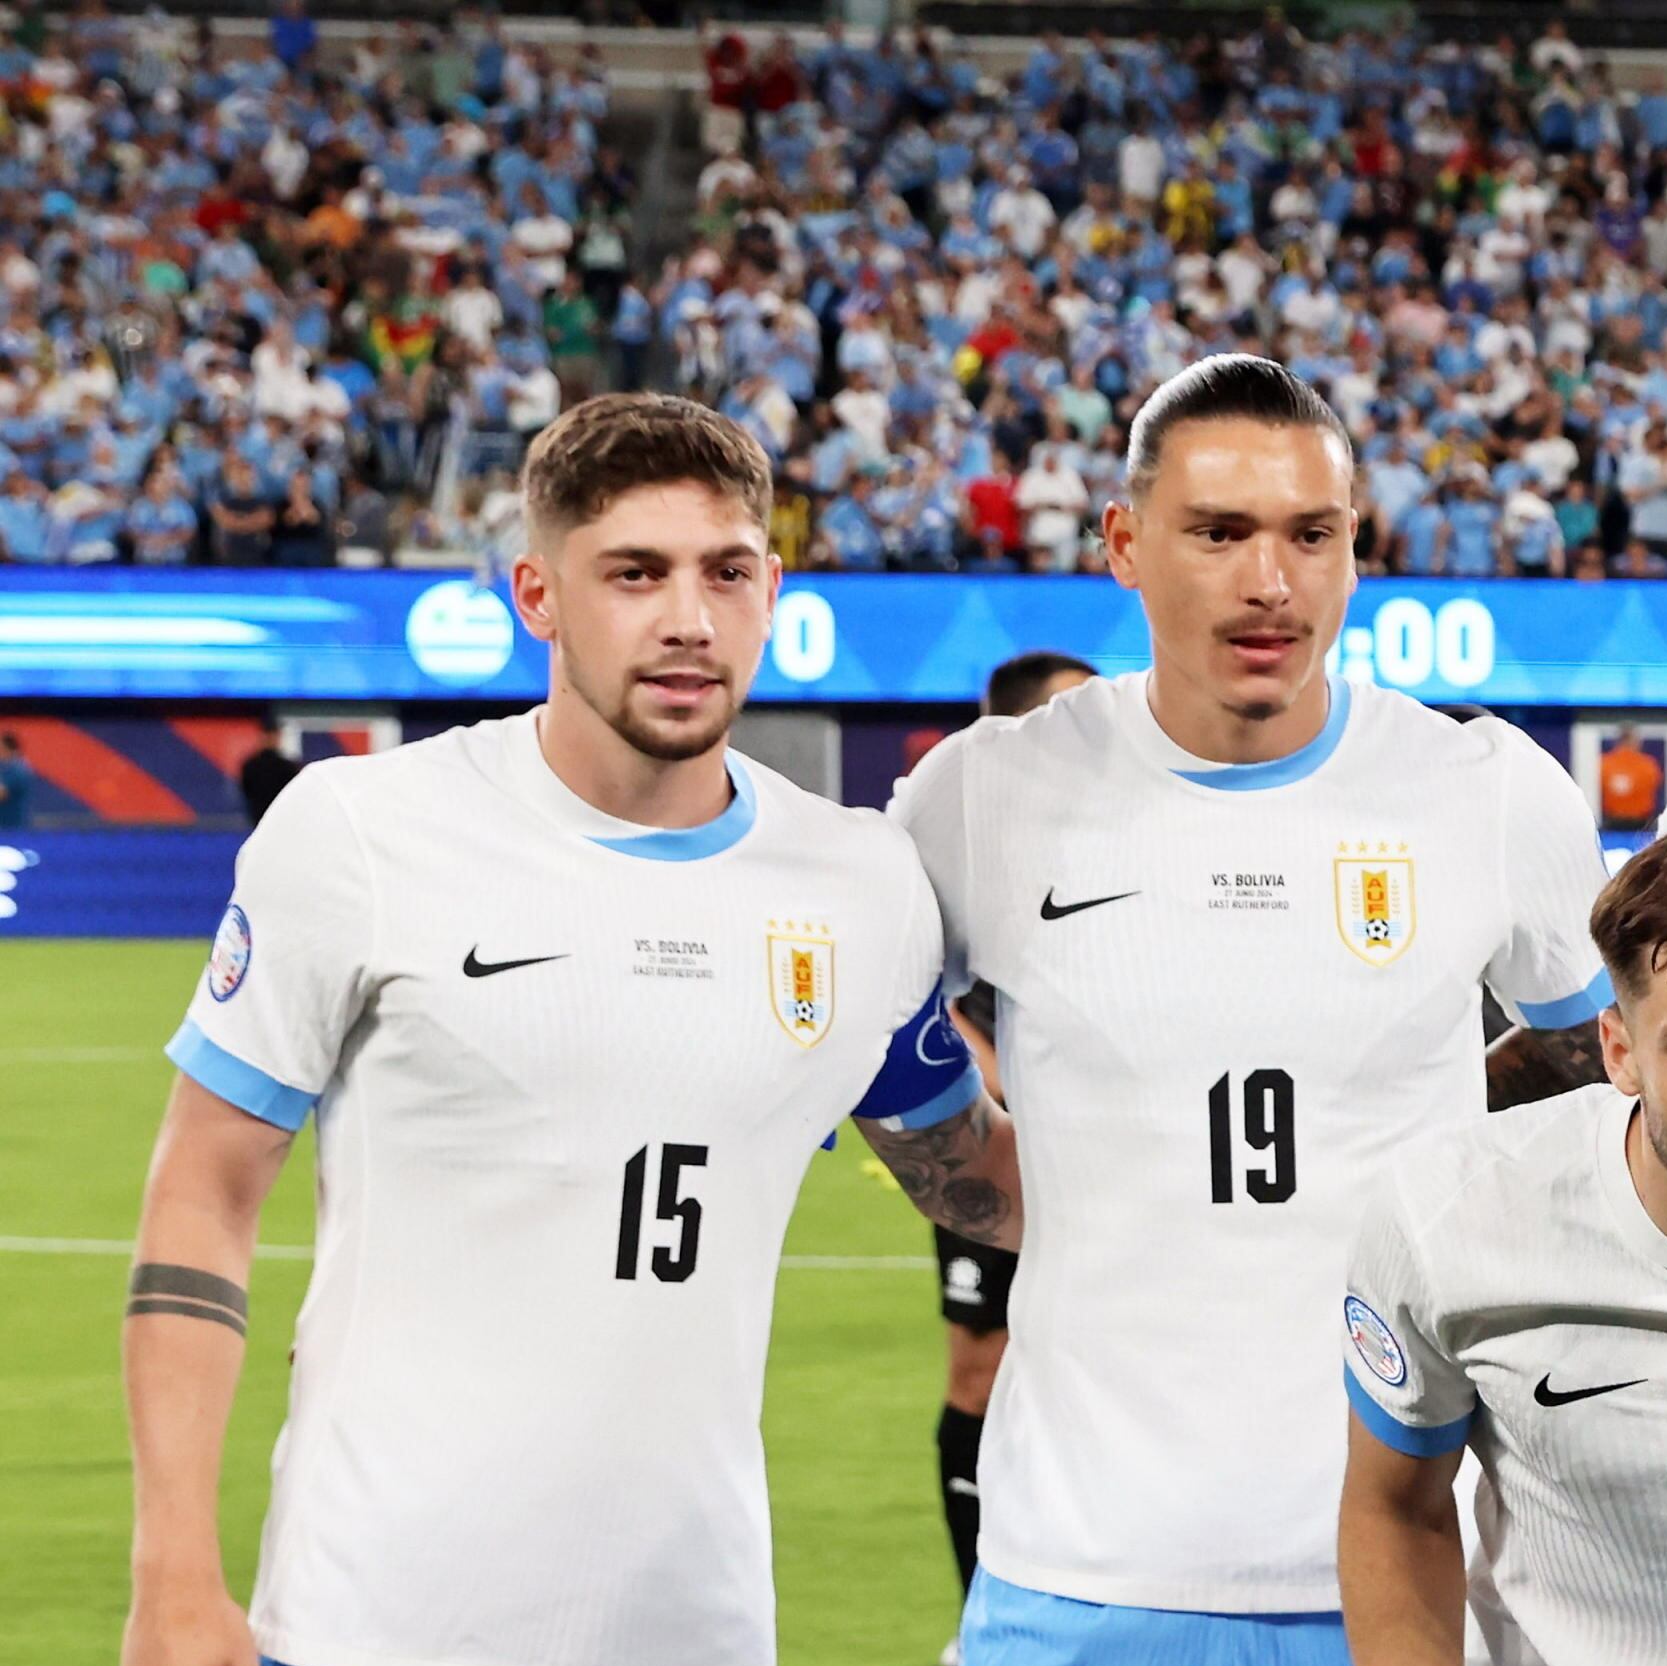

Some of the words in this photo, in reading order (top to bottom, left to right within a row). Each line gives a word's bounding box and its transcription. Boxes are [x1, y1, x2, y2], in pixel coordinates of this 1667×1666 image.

[1212, 873, 1232, 887] VS.
[1236, 873, 1285, 887] BOLIVIA
[1209, 1070, 1295, 1204] 19
[616, 1144, 707, 1282] 15
